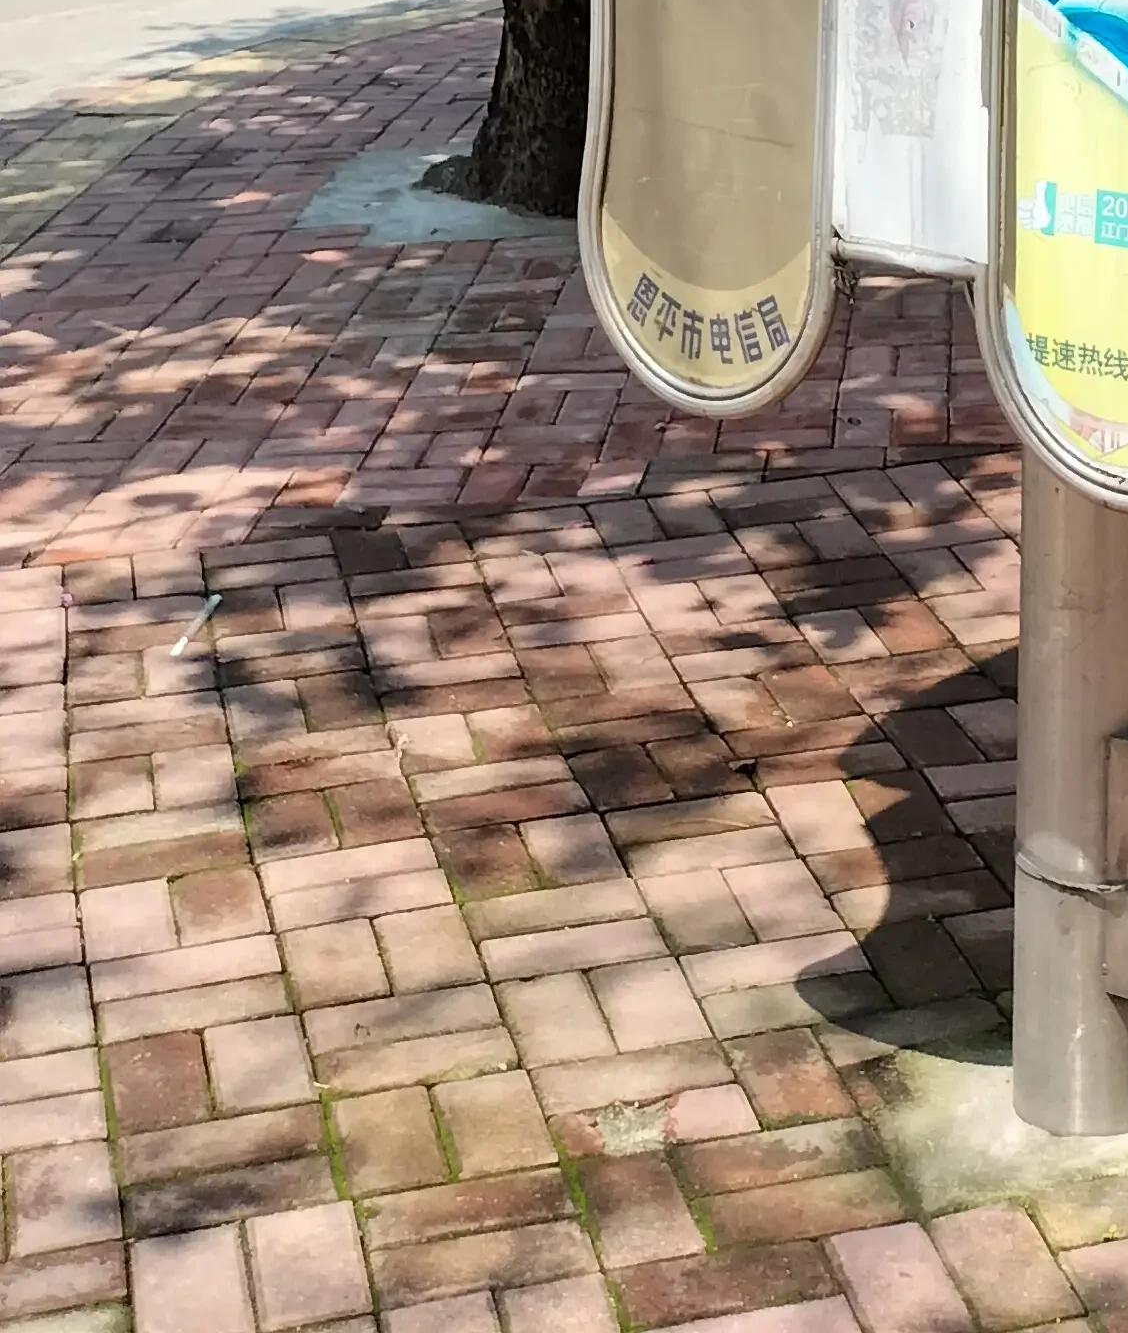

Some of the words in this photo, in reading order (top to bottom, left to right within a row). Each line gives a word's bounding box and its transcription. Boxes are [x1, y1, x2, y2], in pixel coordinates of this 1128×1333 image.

[627, 273, 790, 364] 恩平市电信局
